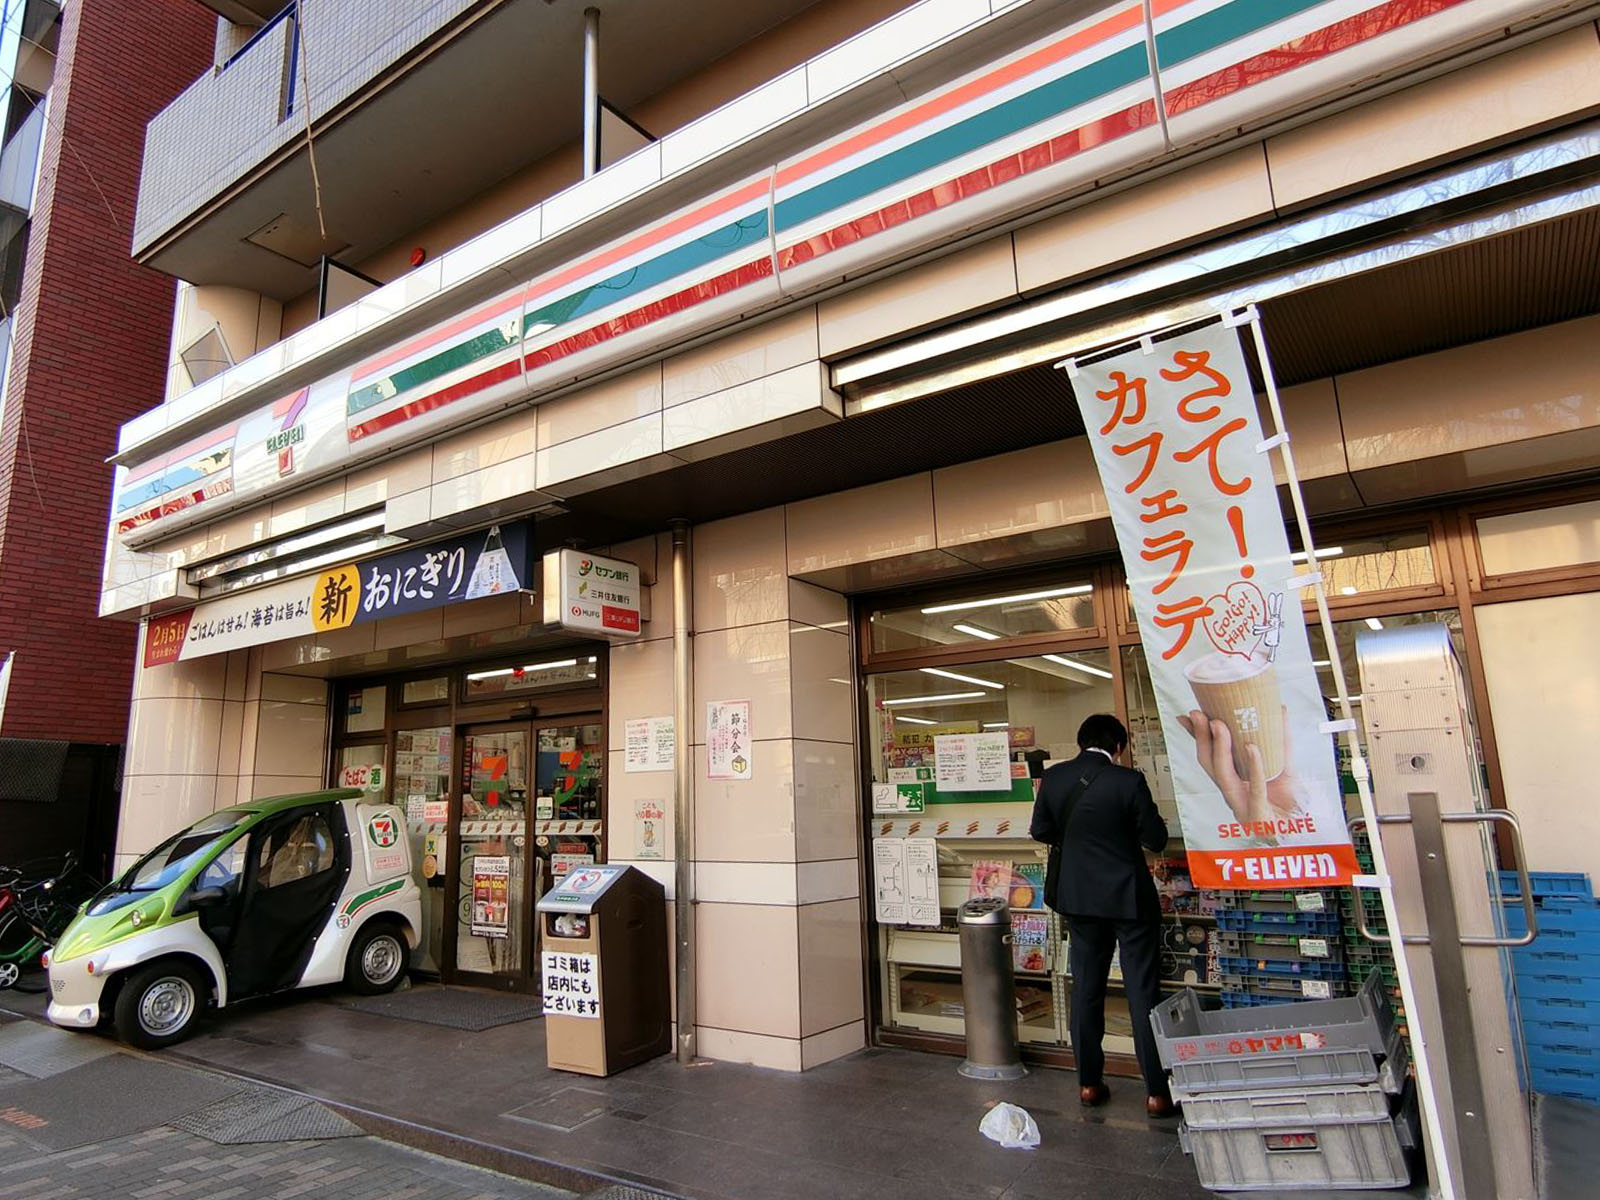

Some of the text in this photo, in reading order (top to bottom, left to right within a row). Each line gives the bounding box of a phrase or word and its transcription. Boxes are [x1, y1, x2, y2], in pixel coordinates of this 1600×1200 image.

[1160, 350, 1254, 578] さて!
[1095, 370, 1213, 661] カフェラテ
[595, 565, 629, 582] セブン銀行
[319, 573, 352, 625] 新
[363, 547, 466, 613] おにぎり
[591, 589, 630, 605] 三井住友銀行
[582, 610, 601, 618] MUFG
[152, 620, 186, 647] 2月5日
[345, 769, 367, 786] たばこ
[371, 768, 381, 785] 酒
[1217, 813, 1316, 839] SEVEN CAFÉ
[548, 957, 591, 974] ゴミ箱は
[547, 976, 592, 995] 店内にも
[543, 996, 599, 1015] ございます
